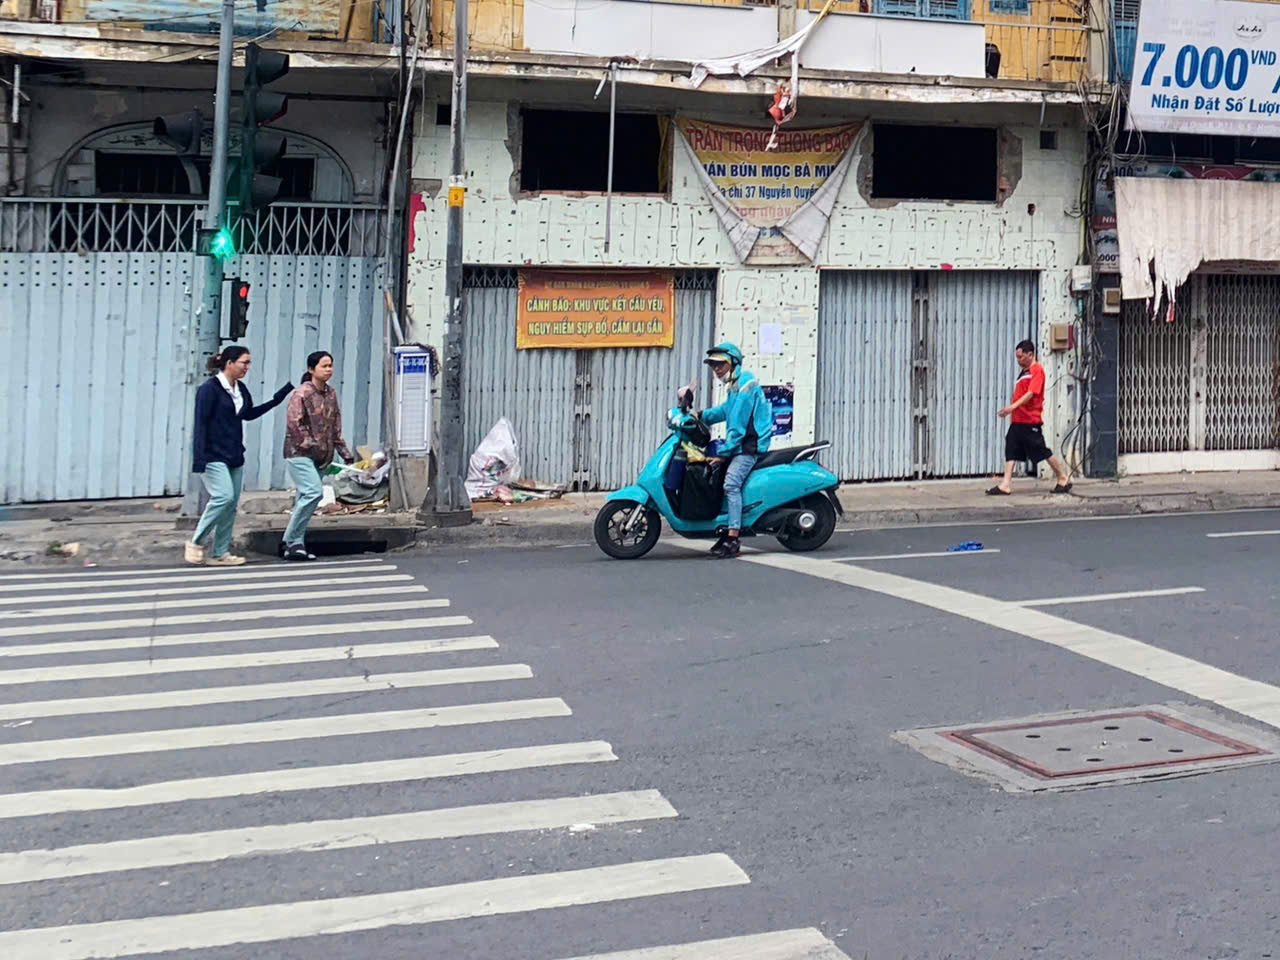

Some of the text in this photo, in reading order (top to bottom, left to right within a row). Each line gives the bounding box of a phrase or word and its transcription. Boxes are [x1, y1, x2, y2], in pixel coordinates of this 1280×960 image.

[1151, 94, 1189, 114] Nhận
[1194, 96, 1221, 115] Đặt
[1225, 96, 1247, 113] Số
[731, 161, 757, 177] BÚN
[762, 164, 790, 180] MỌC
[745, 186, 756, 198] 37
[527, 295, 665, 314] CẢNH BÁO: KHU VỰC KẾT CẤU YẾU,
[528, 321, 551, 336] NGUY
[553, 316, 574, 335] HIỂM
[577, 321, 594, 337] SỤP
[612, 318, 630, 334] CẤM
[632, 321, 645, 336] LẠI
